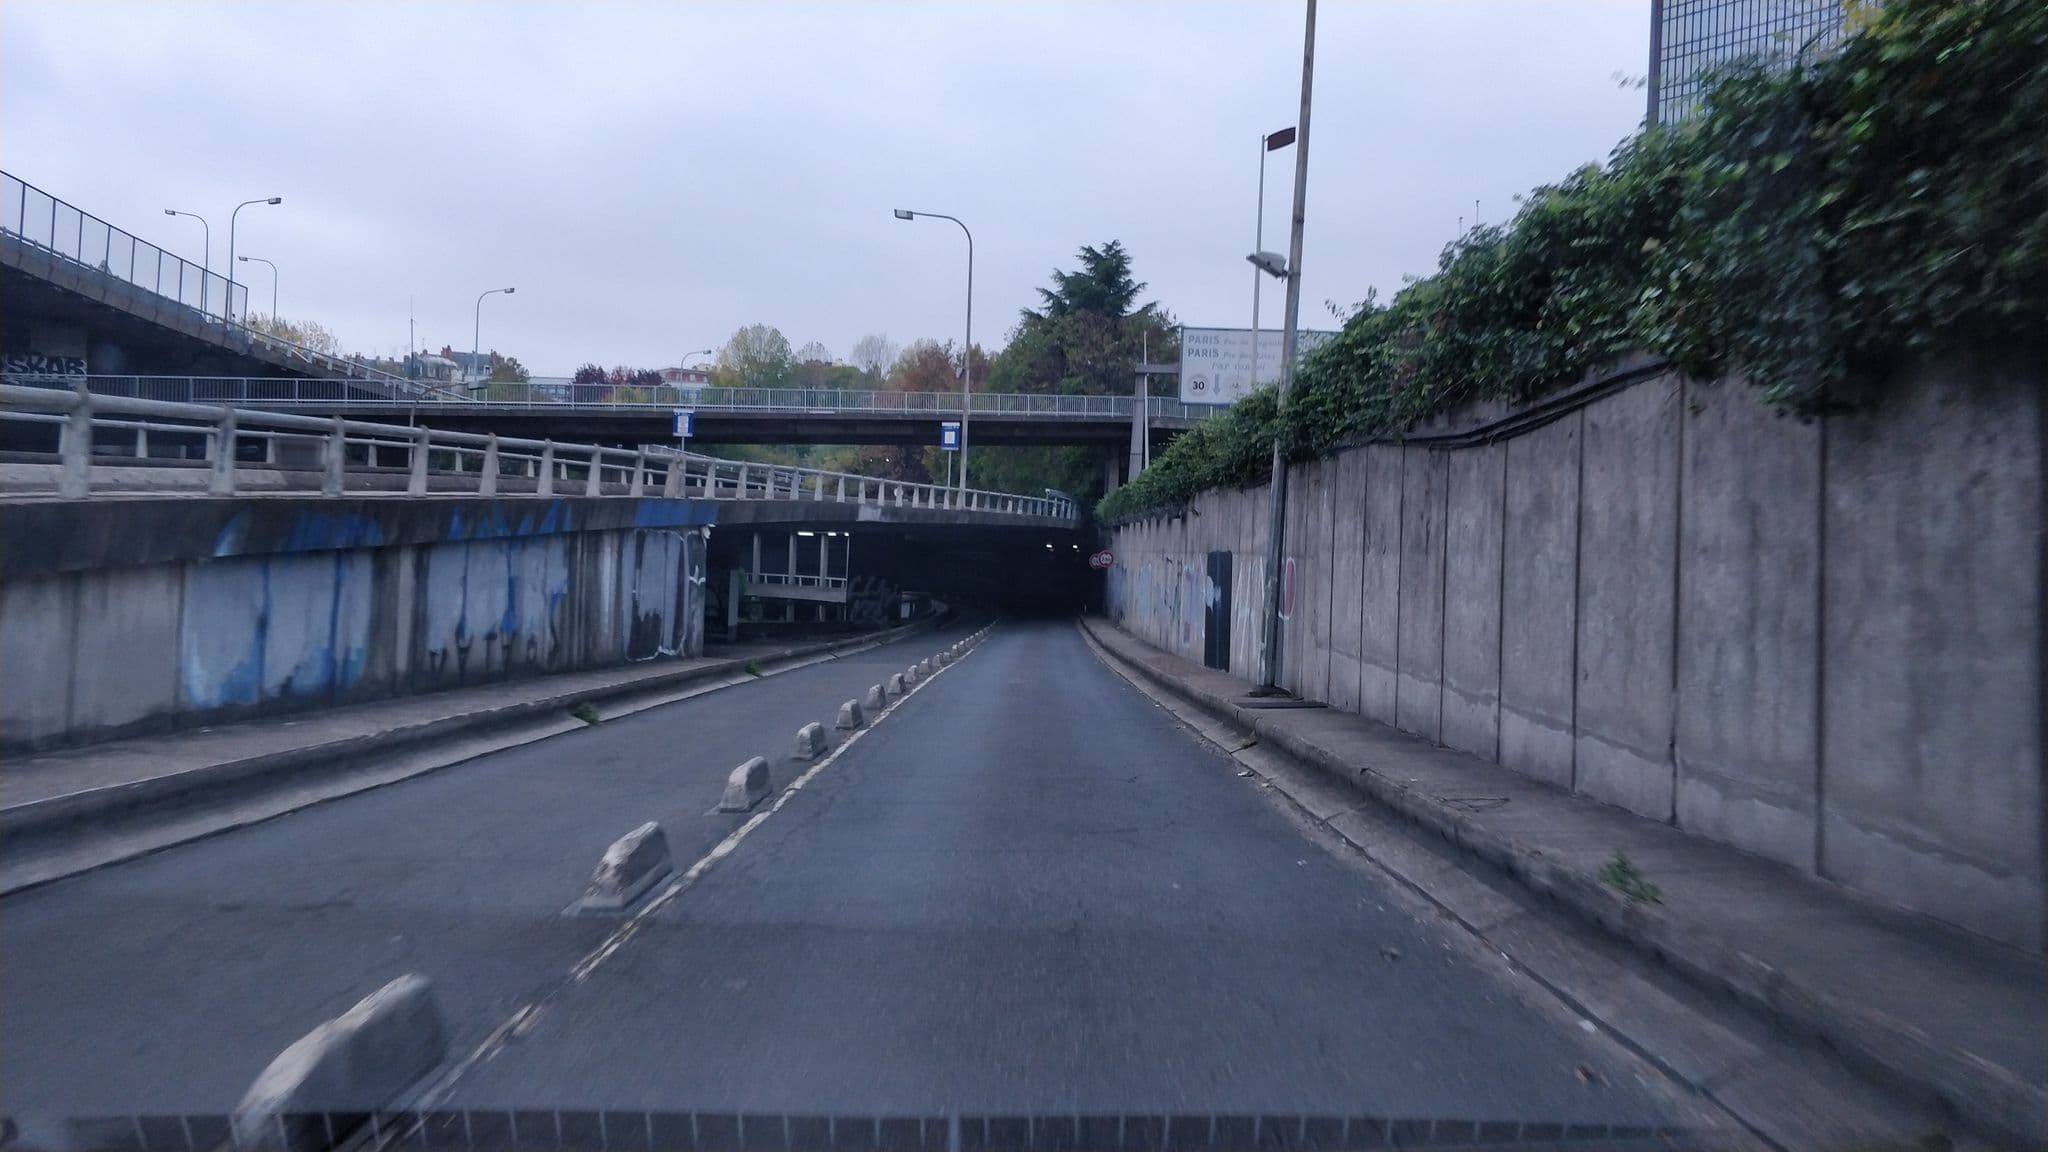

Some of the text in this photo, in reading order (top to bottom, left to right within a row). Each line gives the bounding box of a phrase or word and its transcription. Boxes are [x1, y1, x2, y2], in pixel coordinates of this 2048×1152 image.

[1188, 335, 1220, 345] PARIS
[1187, 348, 1219, 358] PARIS
[1192, 381, 1205, 390] 30
